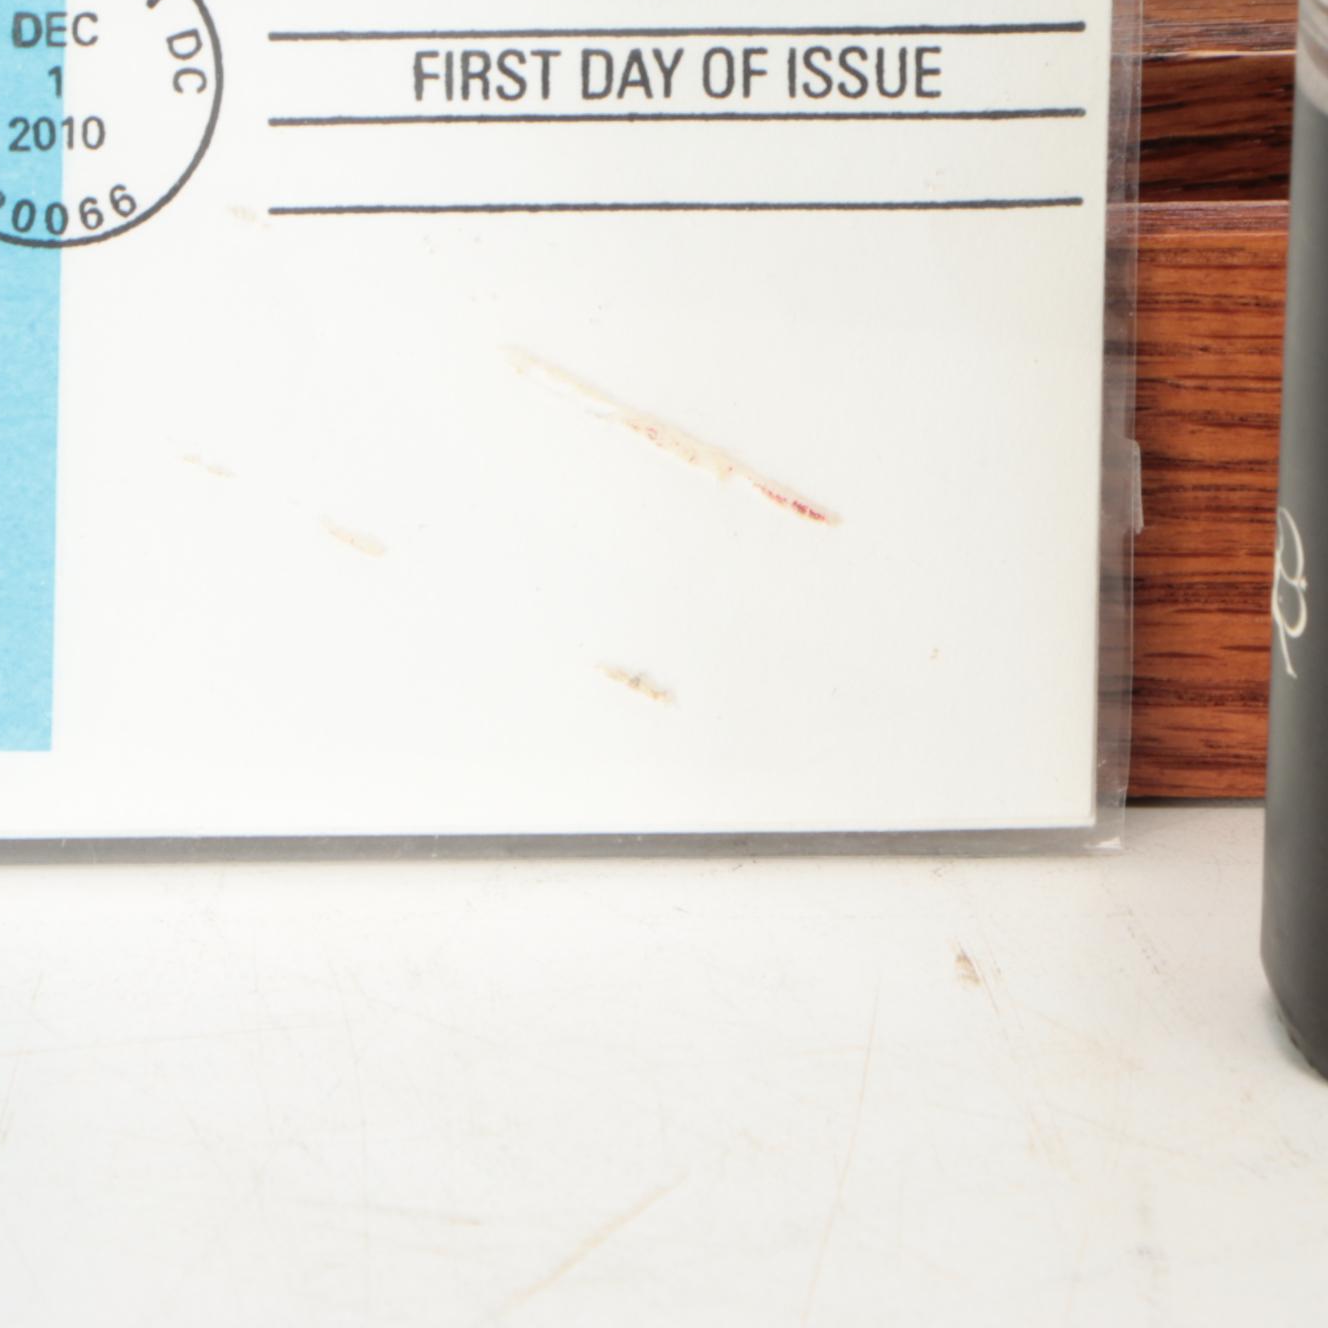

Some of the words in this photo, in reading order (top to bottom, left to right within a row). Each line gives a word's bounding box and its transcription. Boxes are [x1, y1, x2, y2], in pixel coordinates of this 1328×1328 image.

[11, 11, 98, 48] DEC
[166, 29, 208, 94] DC
[412, 49, 561, 101] FIRST
[579, 48, 685, 100] DAY
[701, 47, 768, 99] OF
[786, 46, 943, 99] ISSUE
[47, 65, 62, 98] 1
[7, 115, 105, 152] 2010
